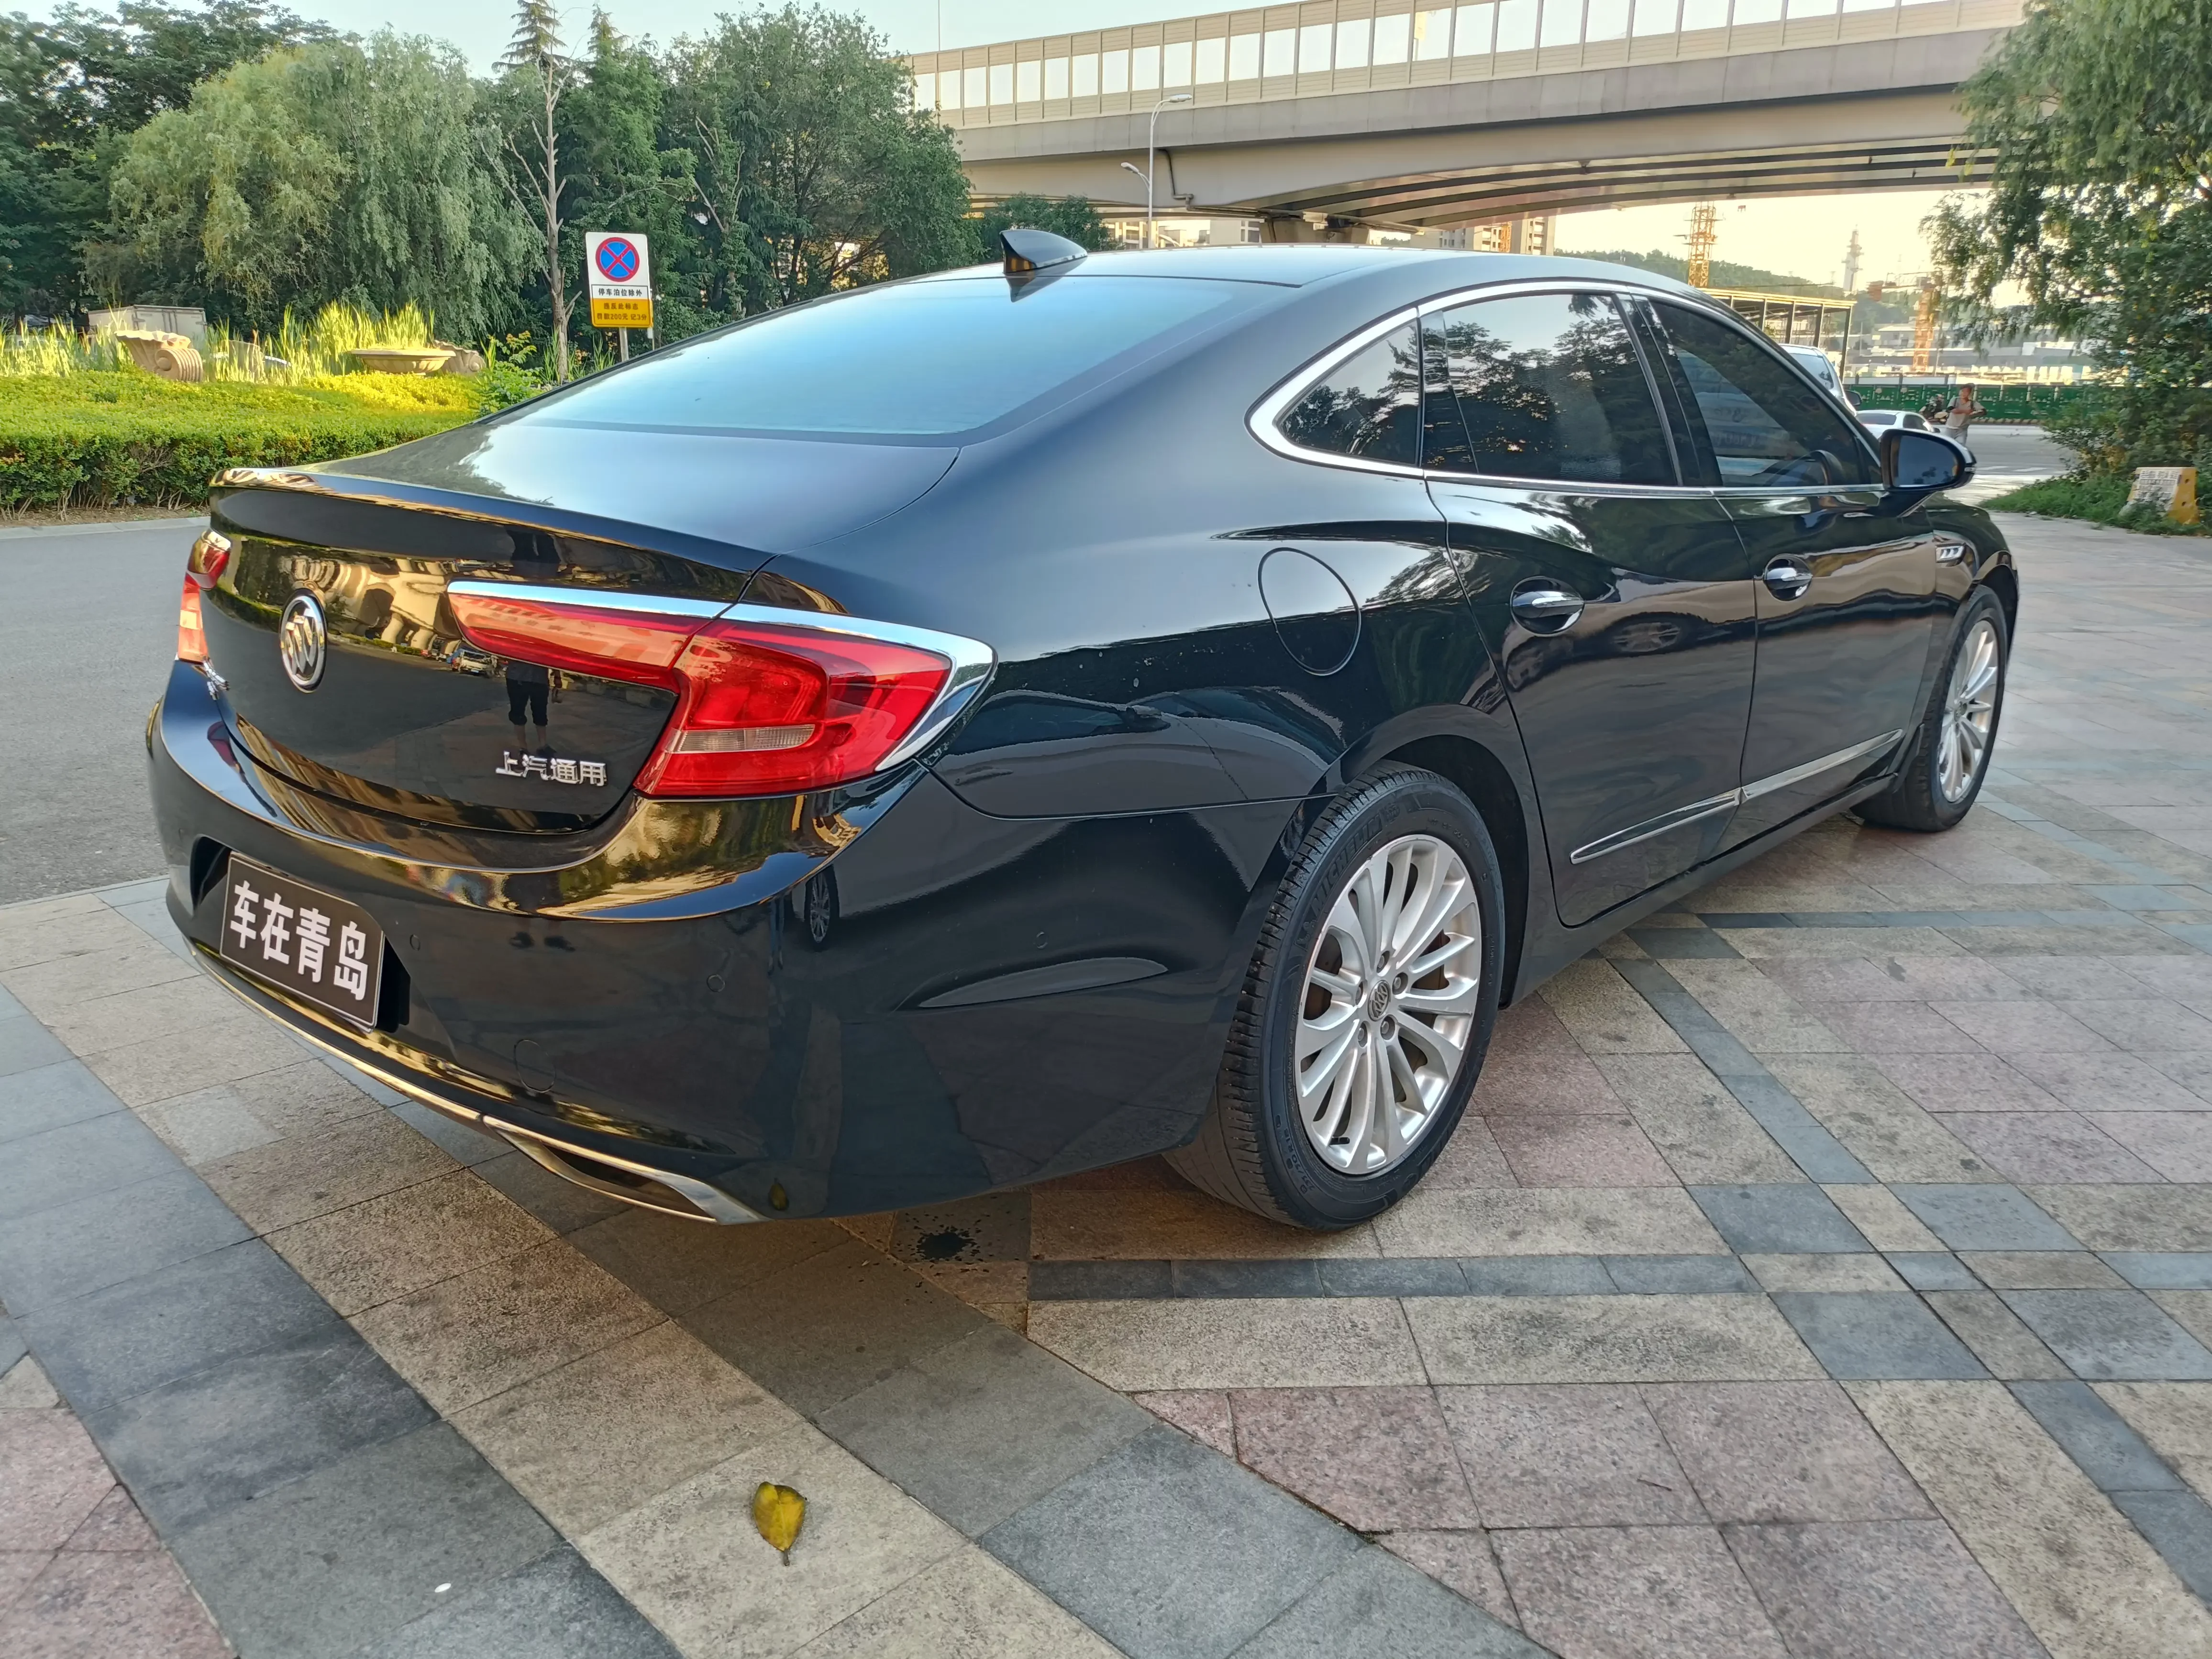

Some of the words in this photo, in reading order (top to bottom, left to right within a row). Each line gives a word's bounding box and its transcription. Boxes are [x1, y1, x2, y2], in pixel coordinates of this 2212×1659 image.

[598, 288, 642, 297] 停车泊位除外
[495, 751, 607, 786] 上汽通用
[1311, 813, 1382, 915] MICHELIN
[230, 880, 368, 1000] 车在青岛
